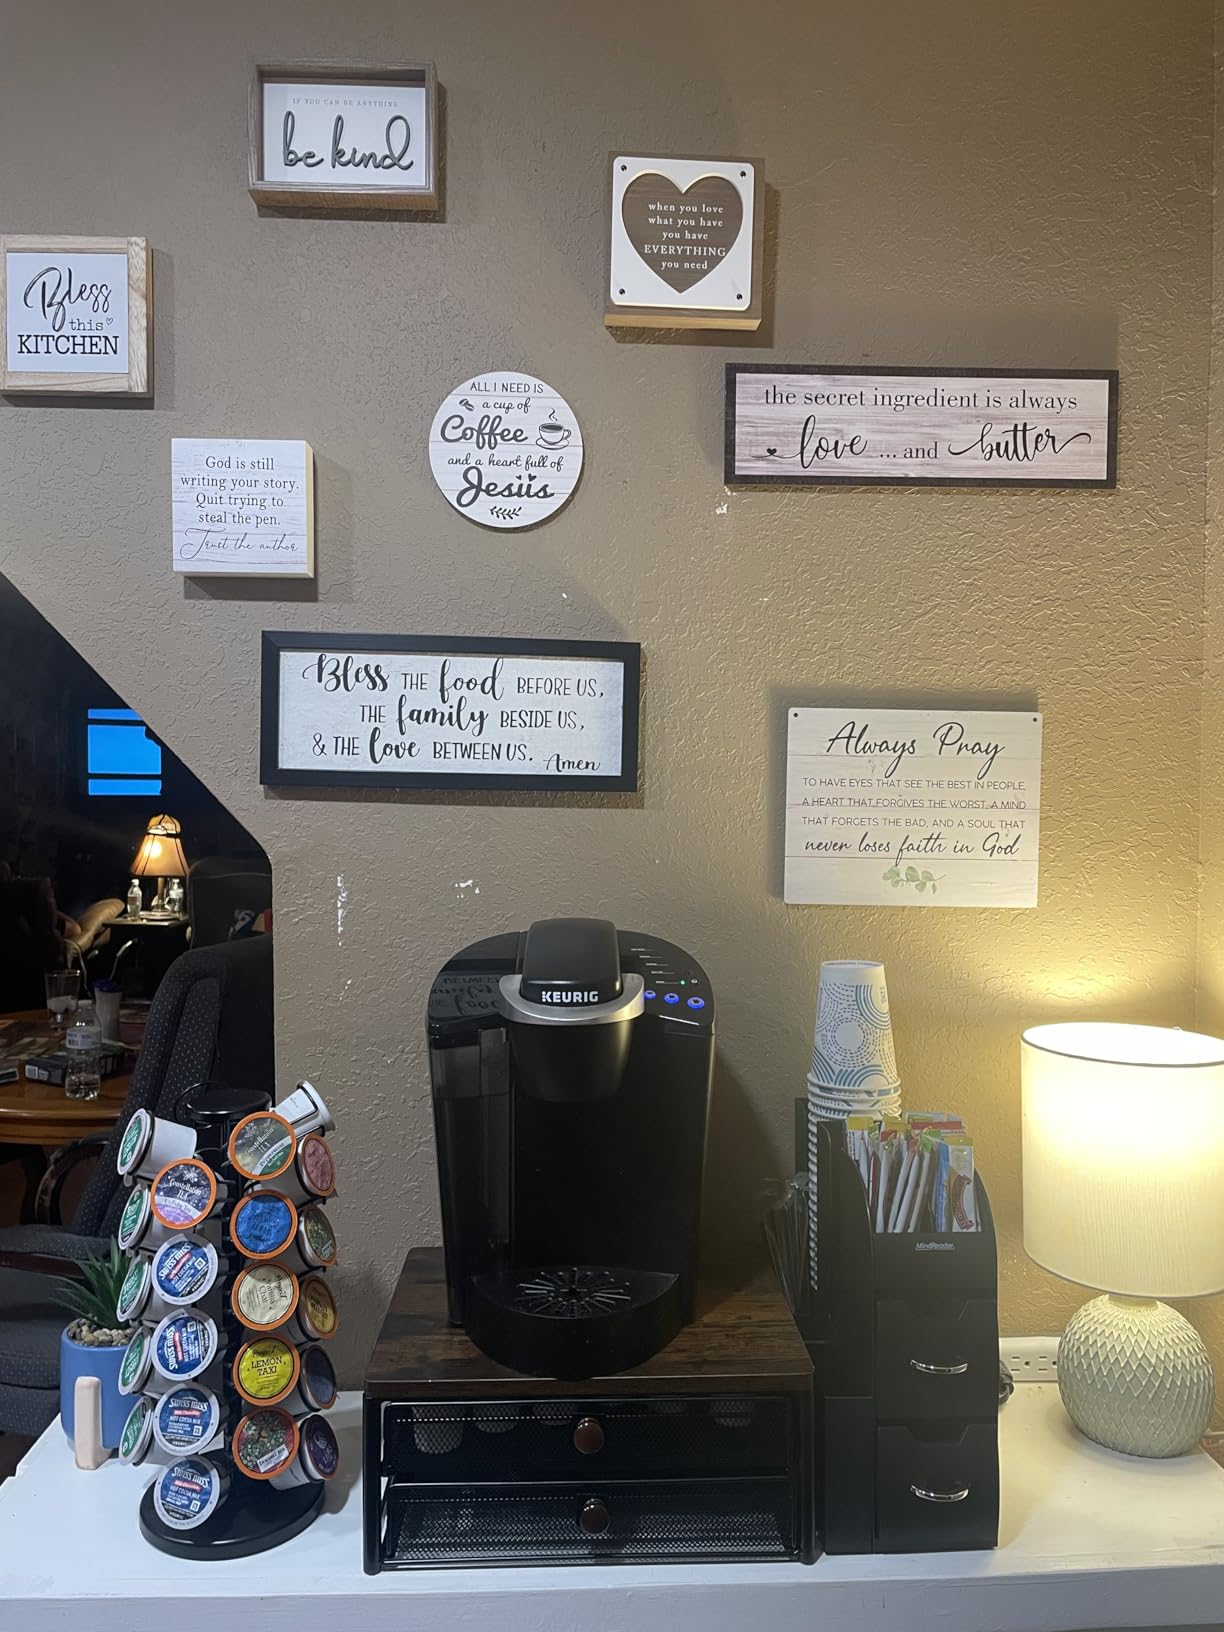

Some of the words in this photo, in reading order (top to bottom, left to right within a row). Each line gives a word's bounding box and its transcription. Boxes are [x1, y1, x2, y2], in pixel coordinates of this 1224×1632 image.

[357, 100, 399, 108] ANYTHING
[282, 110, 324, 168] be
[331, 114, 414, 171] kind
[648, 202, 675, 212] when
[679, 204, 698, 214] you
[702, 203, 724, 213] love
[648, 216, 673, 225] what
[677, 218, 696, 228] you
[700, 217, 723, 227] have
[662, 231, 681, 241] you
[685, 230, 708, 240] have
[644, 244, 726, 257] EVERYTHING
[661, 261, 679, 270] you
[684, 260, 708, 270] need
[23, 266, 112, 332] Bless
[68, 318, 104, 331] this
[17, 334, 120, 355] KITCHEN
[470, 381, 491, 392] ALL
[501, 383, 531, 393] NEED
[533, 383, 544, 394] IS
[493, 402, 515, 414] cup
[517, 397, 531, 414] of
[765, 385, 797, 405] the
[803, 390, 865, 406] secret
[873, 387, 978, 413] ingredient
[986, 389, 1002, 408] is
[1009, 389, 1078, 414] always
[440, 414, 528, 450] Coffee
[777, 414, 868, 469] love
[903, 441, 938, 459] and
[947, 422, 1092, 462] butter
[205, 456, 231, 469] God
[236, 457, 246, 470] is
[250, 457, 275, 471] still
[447, 453, 471, 466] and
[488, 453, 522, 468] heart
[524, 455, 549, 472] full
[550, 456, 564, 472] of
[181, 474, 227, 490] writing
[231, 478, 260, 491] your
[263, 478, 299, 493] story.
[196, 492, 223, 508] Quit
[228, 494, 267, 510] trying
[271, 495, 284, 507] to
[198, 511, 227, 524] steal
[232, 511, 251, 524] the
[255, 515, 281, 528] pen.
[179, 527, 229, 560] Trust
[231, 532, 253, 550] the
[259, 533, 298, 551] author
[302, 653, 390, 692] Bless
[401, 672, 429, 690] THE
[439, 657, 504, 704] food
[517, 676, 572, 696] BEFORE
[576, 678, 604, 698] US,
[360, 704, 387, 723] THE
[396, 695, 489, 737] family
[500, 709, 553, 728] BESIDE
[558, 710, 585, 732] US,
[312, 732, 327, 757] &
[333, 736, 361, 756] THE
[369, 726, 421, 765] love
[433, 741, 502, 761] BETWEEN
[506, 743, 533, 761] US.
[826, 720, 917, 778] Always
[932, 721, 1006, 780] Pray
[543, 753, 601, 772] Amen
[802, 777, 817, 787] TO
[819, 777, 847, 788] HAVE
[849, 778, 873, 788] EYES
[876, 779, 902, 788] THAT
[904, 779, 922, 789] SEE
[925, 779, 945, 789] THE
[947, 780, 971, 790] BEST
[974, 781, 985, 790] IN
[802, 797, 810, 807] A
[811, 797, 844, 807] HEART
[848, 798, 873, 808] THAT
[876, 798, 924, 809] FORGIVES
[927, 799, 947, 809] THE
[991, 800, 998, 809] A
[1001, 800, 1027, 810] MIND
[802, 816, 829, 826] THAT
[832, 817, 879, 827] FORGETS
[882, 817, 903, 827] THE
[905, 818, 929, 829] BAD,
[932, 818, 954, 828] AND
[957, 819, 965, 828] A
[967, 819, 996, 829] SOUL
[999, 820, 1026, 829] THAT
[804, 838, 852, 853] never
[858, 831, 891, 853] loses
[895, 831, 948, 867] faith
[953, 840, 975, 854] in
[982, 832, 1022, 858] God
[541, 991, 599, 1003] KEURIG
[251, 1355, 283, 1369] LEMON
[257, 1365, 277, 1376] TAXI
